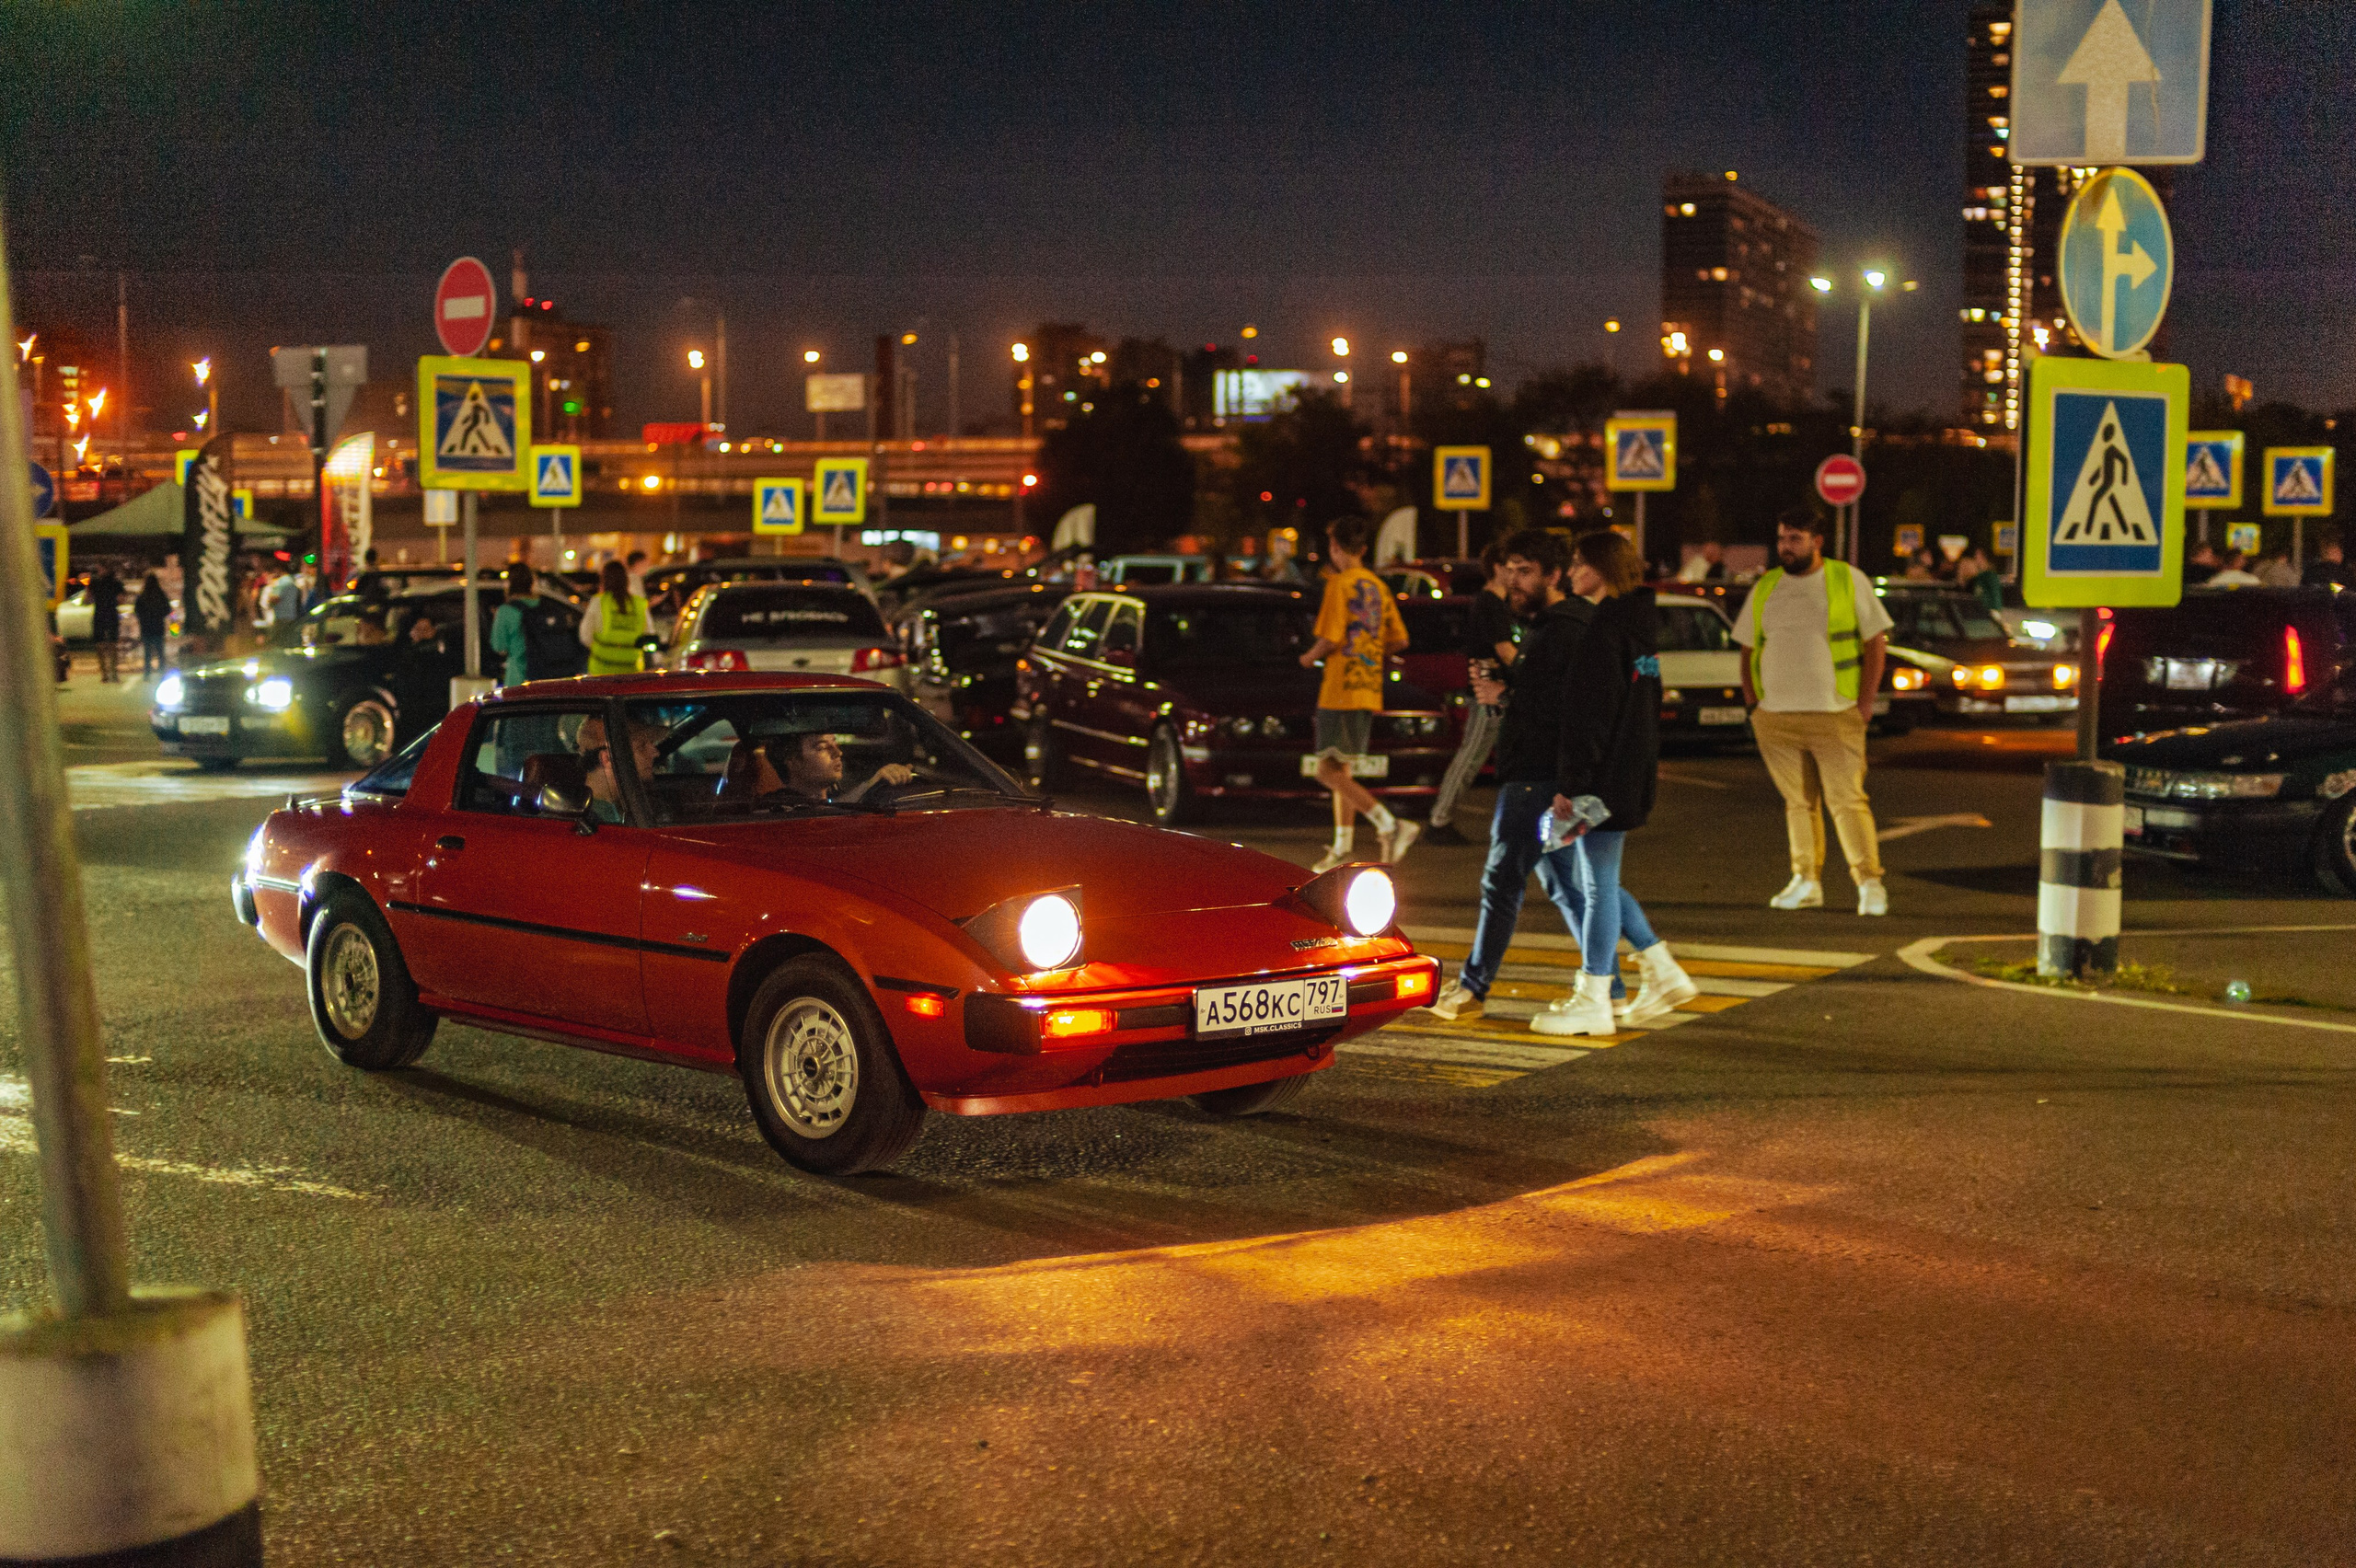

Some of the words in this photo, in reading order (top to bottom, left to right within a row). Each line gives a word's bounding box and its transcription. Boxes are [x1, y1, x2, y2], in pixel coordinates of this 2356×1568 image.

[1307, 979, 1340, 1006] 797
[1313, 1004, 1332, 1015] RUS
[1253, 1021, 1302, 1034] MSK.CLASSICS
